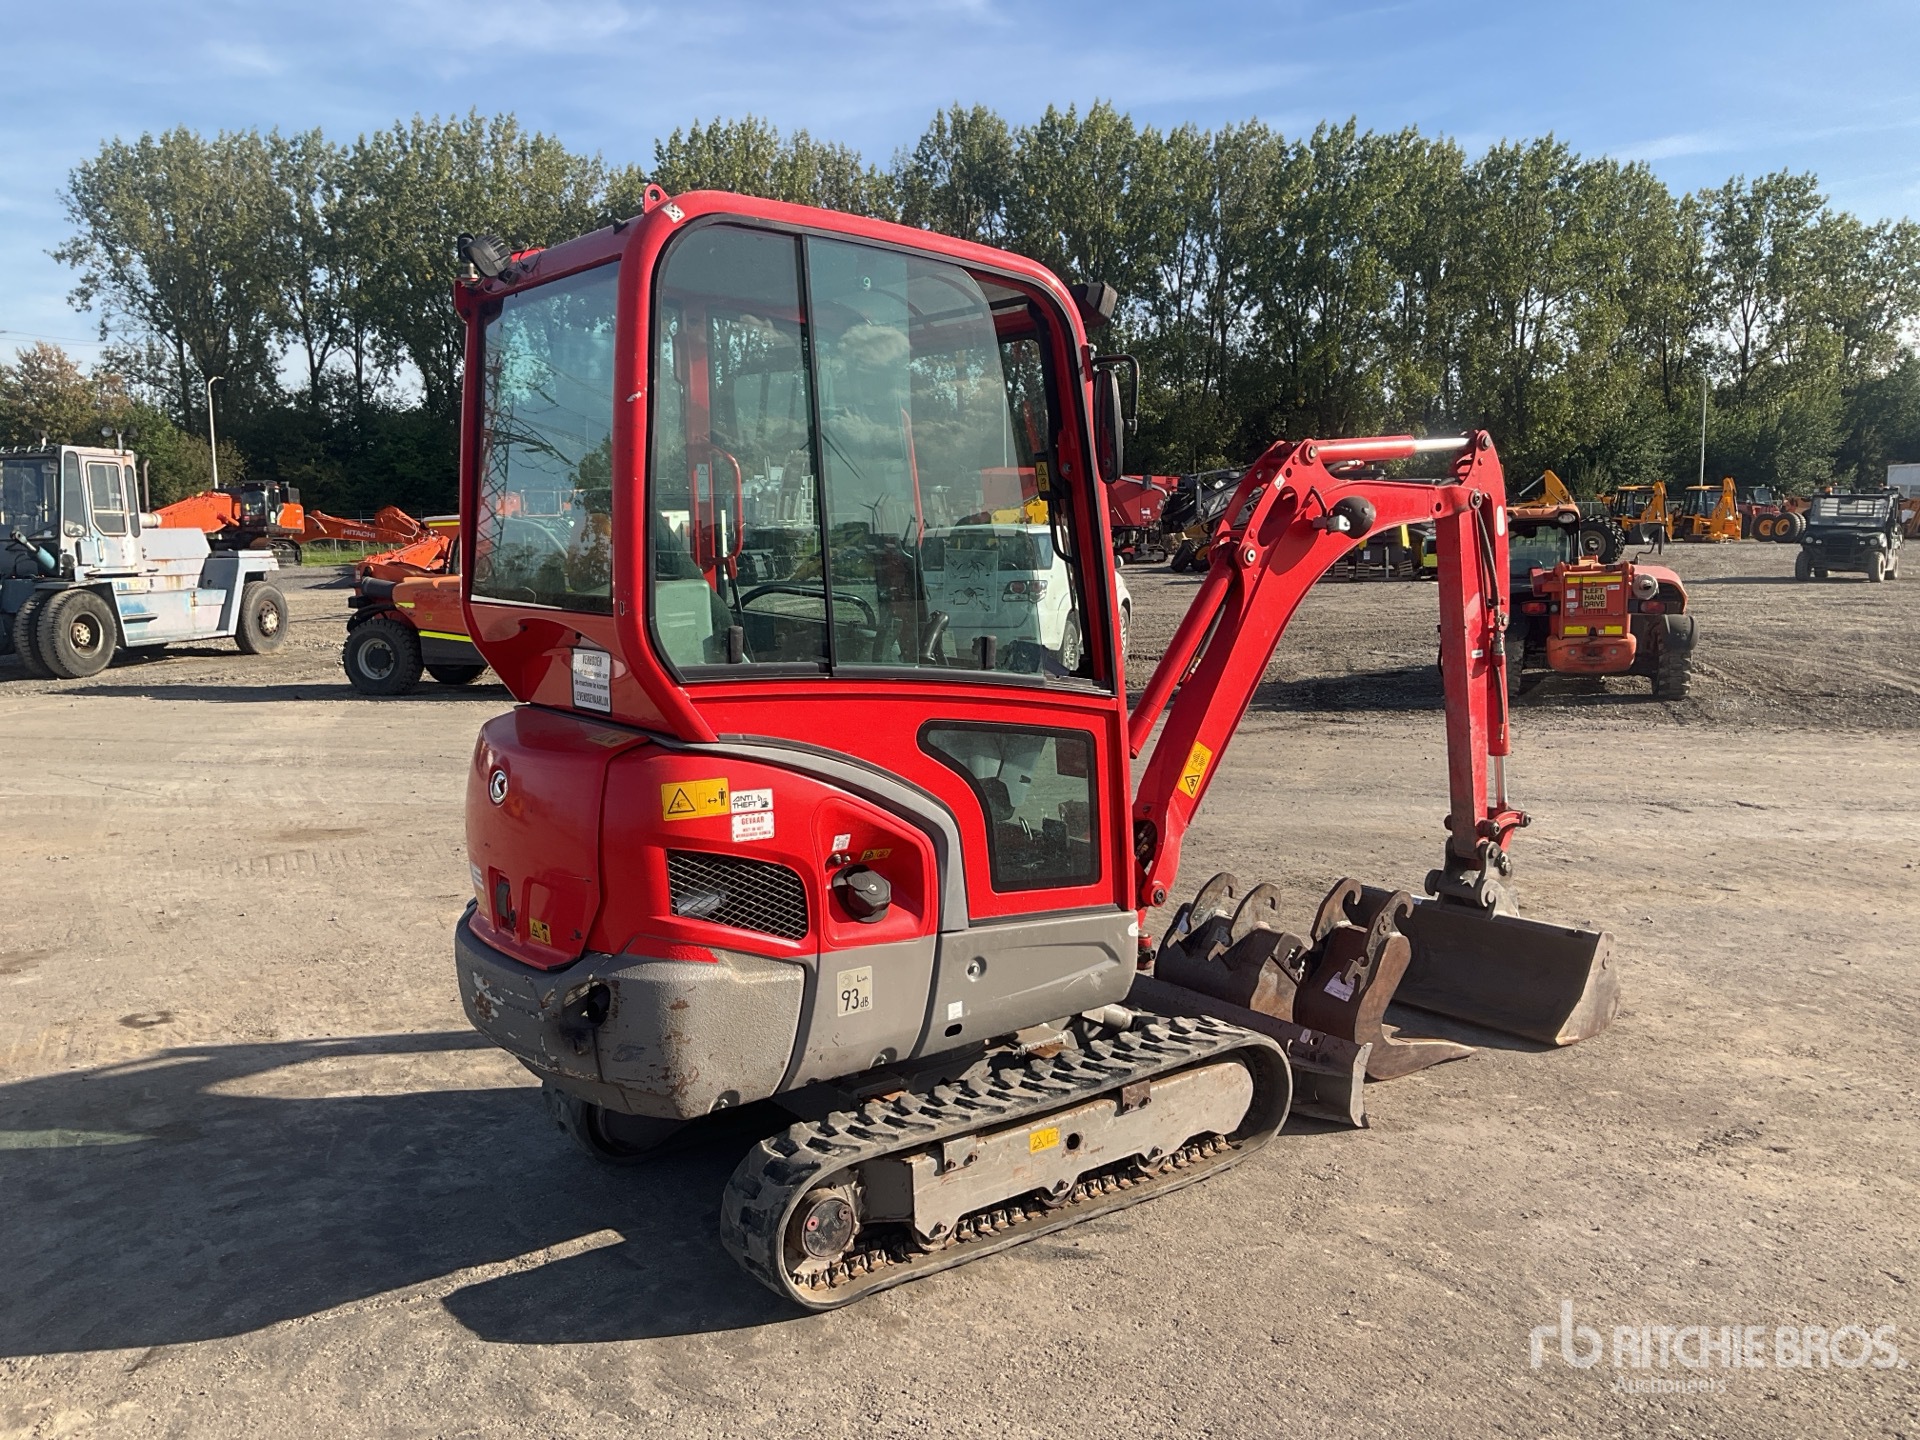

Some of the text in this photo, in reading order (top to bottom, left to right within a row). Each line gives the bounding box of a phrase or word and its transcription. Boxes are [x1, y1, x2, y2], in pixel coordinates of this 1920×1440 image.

[343, 530, 376, 538] HITACHI
[732, 801, 757, 809] THEFT
[741, 816, 764, 825] GEVAAR
